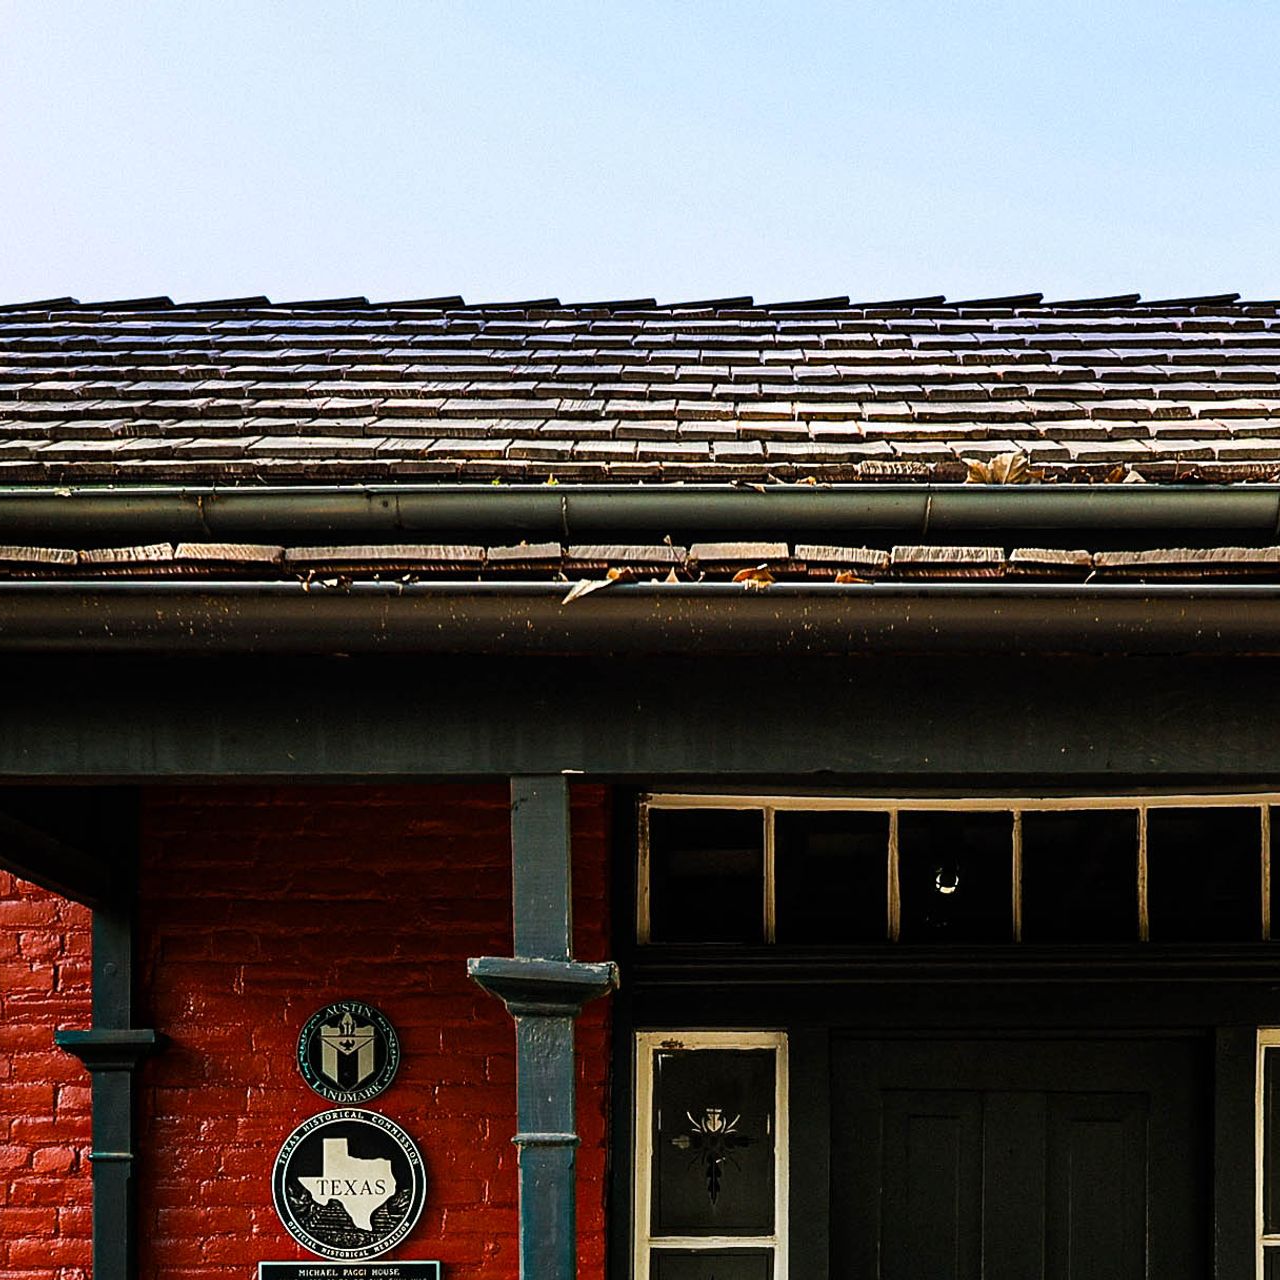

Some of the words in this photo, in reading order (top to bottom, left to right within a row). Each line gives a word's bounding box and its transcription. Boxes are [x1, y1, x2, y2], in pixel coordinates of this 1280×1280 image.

[325, 1003, 374, 1018] AUSTIN
[312, 1080, 383, 1103] LANDMARK
[278, 1134, 301, 1165] TEXAS
[303, 1110, 365, 1133] HISTORICAL
[370, 1115, 420, 1166] COMMISSION
[316, 1179, 386, 1196] TEXAS
[286, 1220, 317, 1250] OFFICIAL
[321, 1245, 370, 1258] HISTORICAL
[373, 1221, 411, 1253] MEDALLION
[298, 1268, 339, 1278] MICHAEL
[343, 1268, 367, 1277] PAGGI
[371, 1268, 401, 1277] HOUSE
